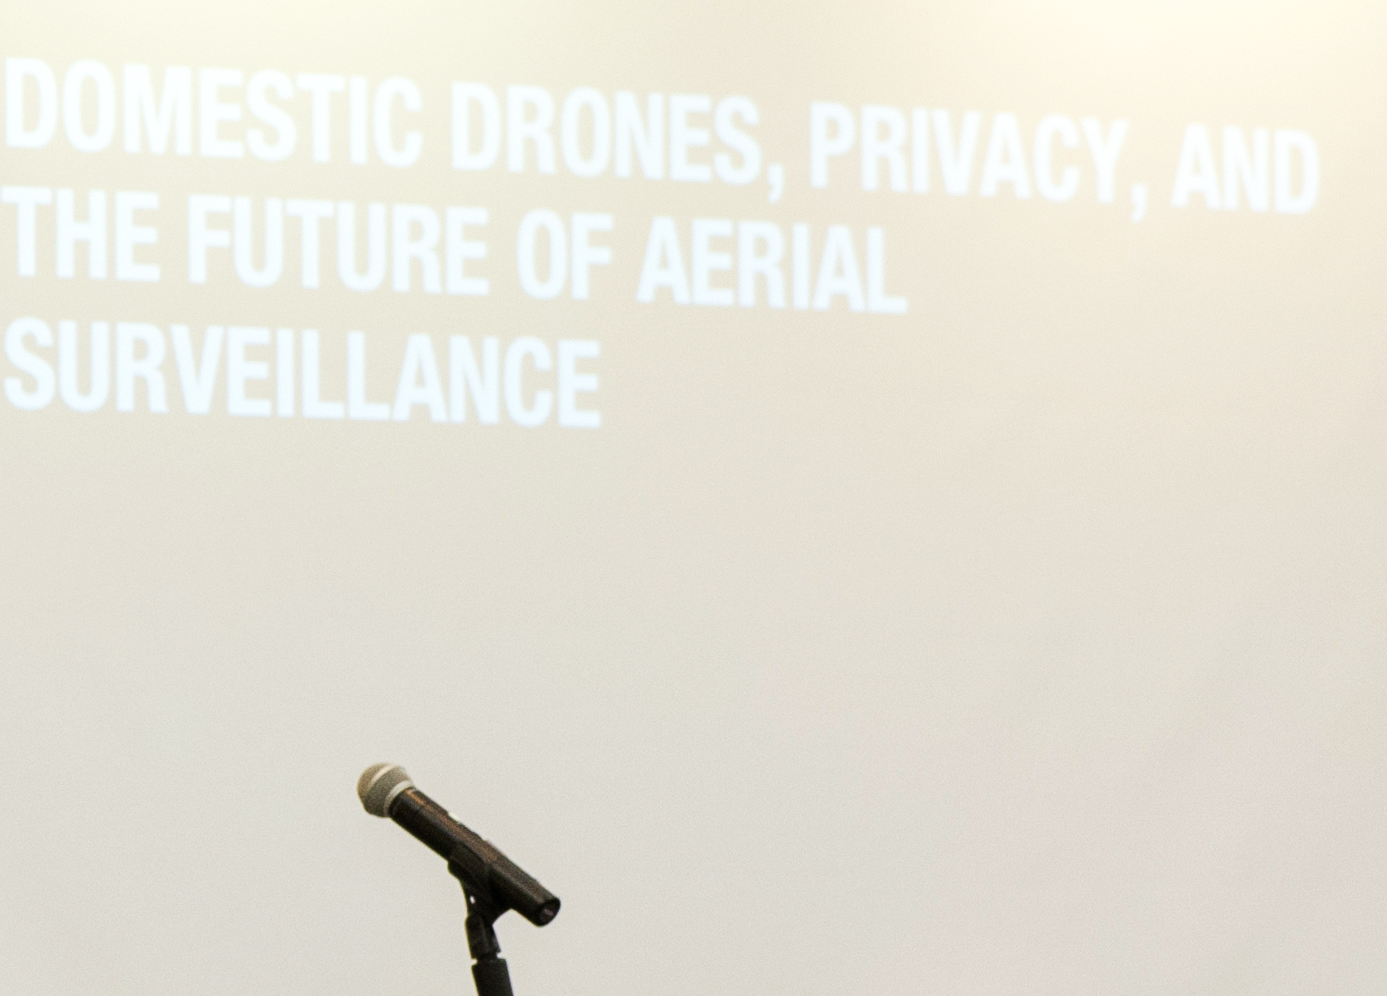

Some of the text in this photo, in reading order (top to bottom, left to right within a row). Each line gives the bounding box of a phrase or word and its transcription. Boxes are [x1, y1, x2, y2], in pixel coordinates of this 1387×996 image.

[2, 54, 1321, 223] DOMESTIC DRONES, PRIVACY, AND
[2, 186, 908, 313] THE FUTURE OF AERIAL
[2, 317, 602, 429] SURVEILLANCE
